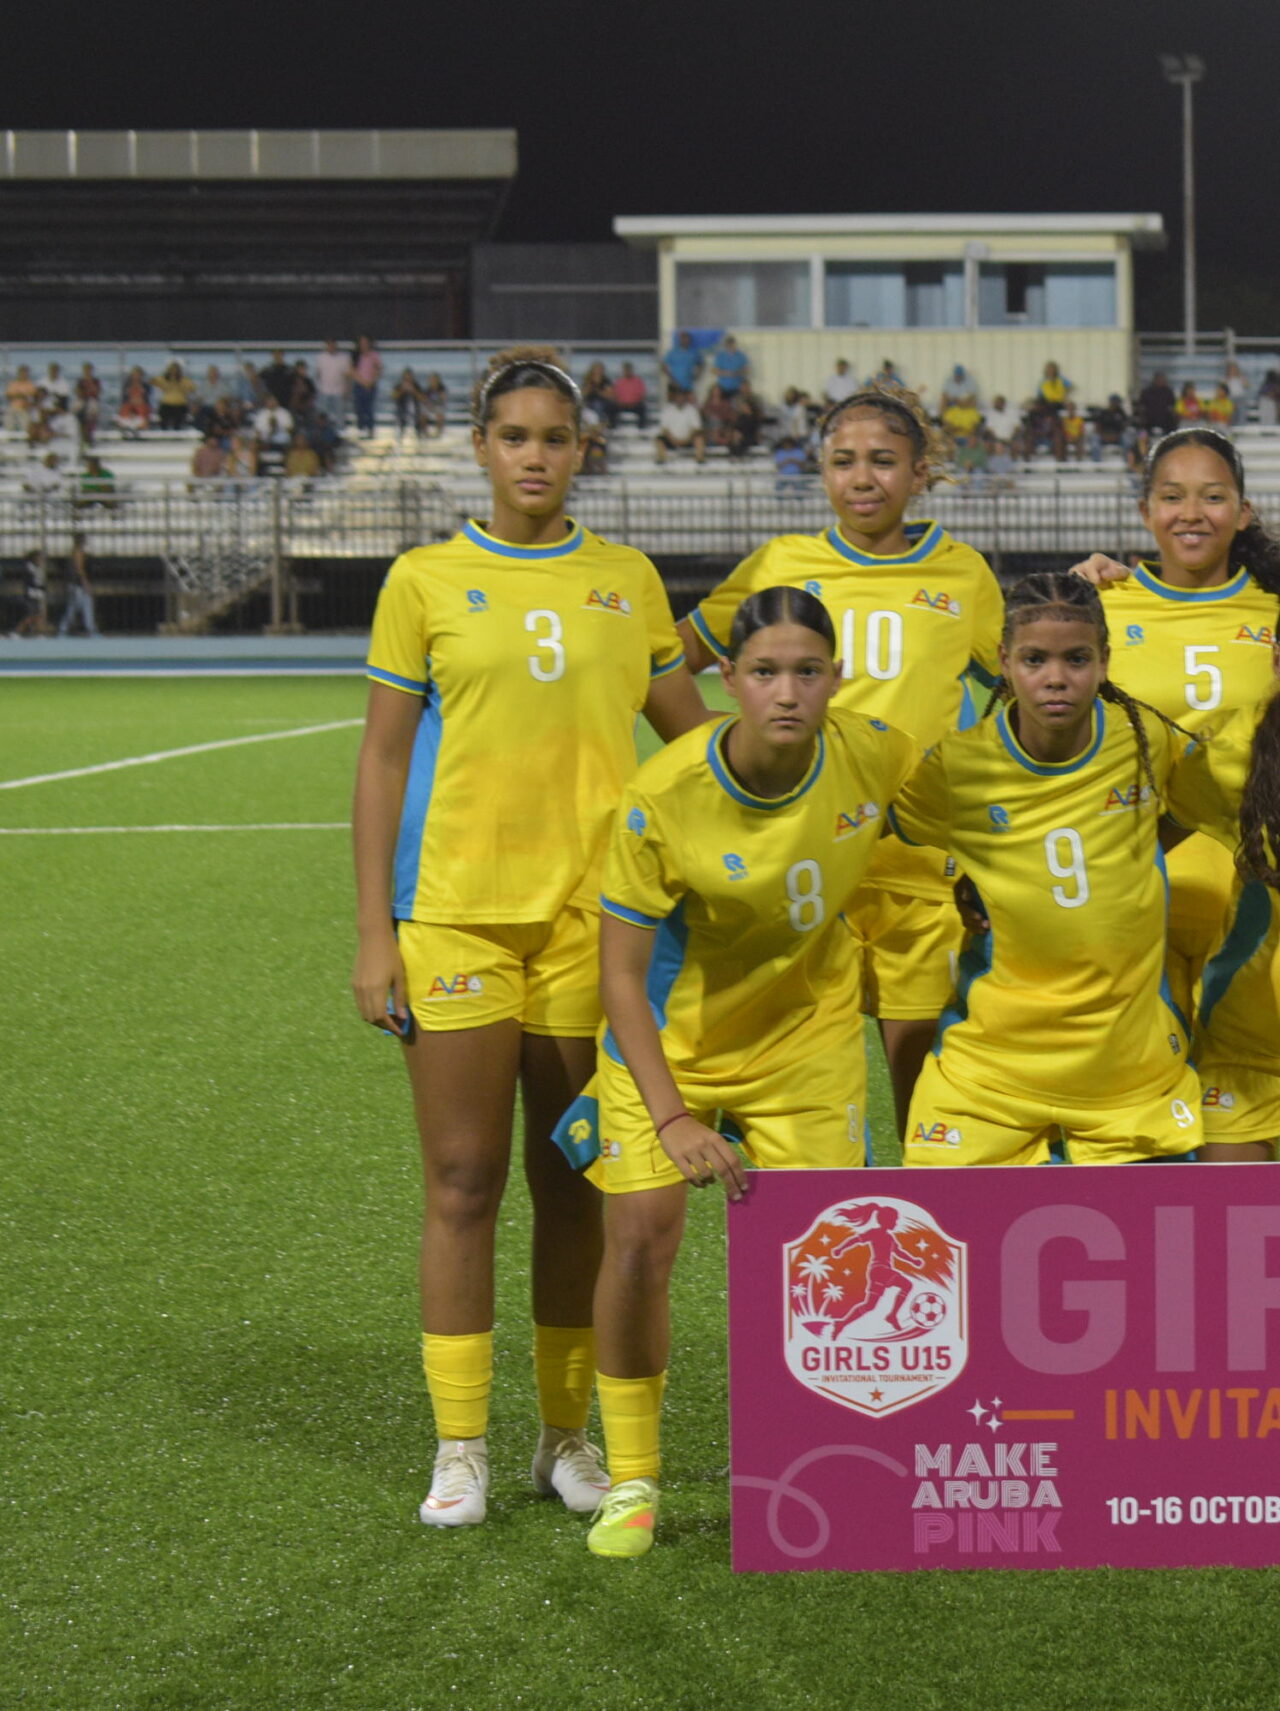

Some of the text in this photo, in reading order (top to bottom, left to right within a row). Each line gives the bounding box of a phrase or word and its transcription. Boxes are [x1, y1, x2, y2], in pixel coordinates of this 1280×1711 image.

[524, 609, 566, 682] 3
[841, 608, 903, 680] 10
[1184, 645, 1222, 710] 5
[1044, 827, 1090, 908] 9
[786, 859, 825, 932] 8
[1170, 1099, 1195, 1128] 9
[802, 1345, 952, 1371] GIRLS U15
[821, 1374, 933, 1383] INVITATIONAL TOURNAMENT
[914, 1443, 1059, 1477] MAKE
[911, 1480, 1063, 1509] ARUBA
[1106, 1497, 1183, 1524] 10-16
[914, 1512, 1064, 1553] PINK
